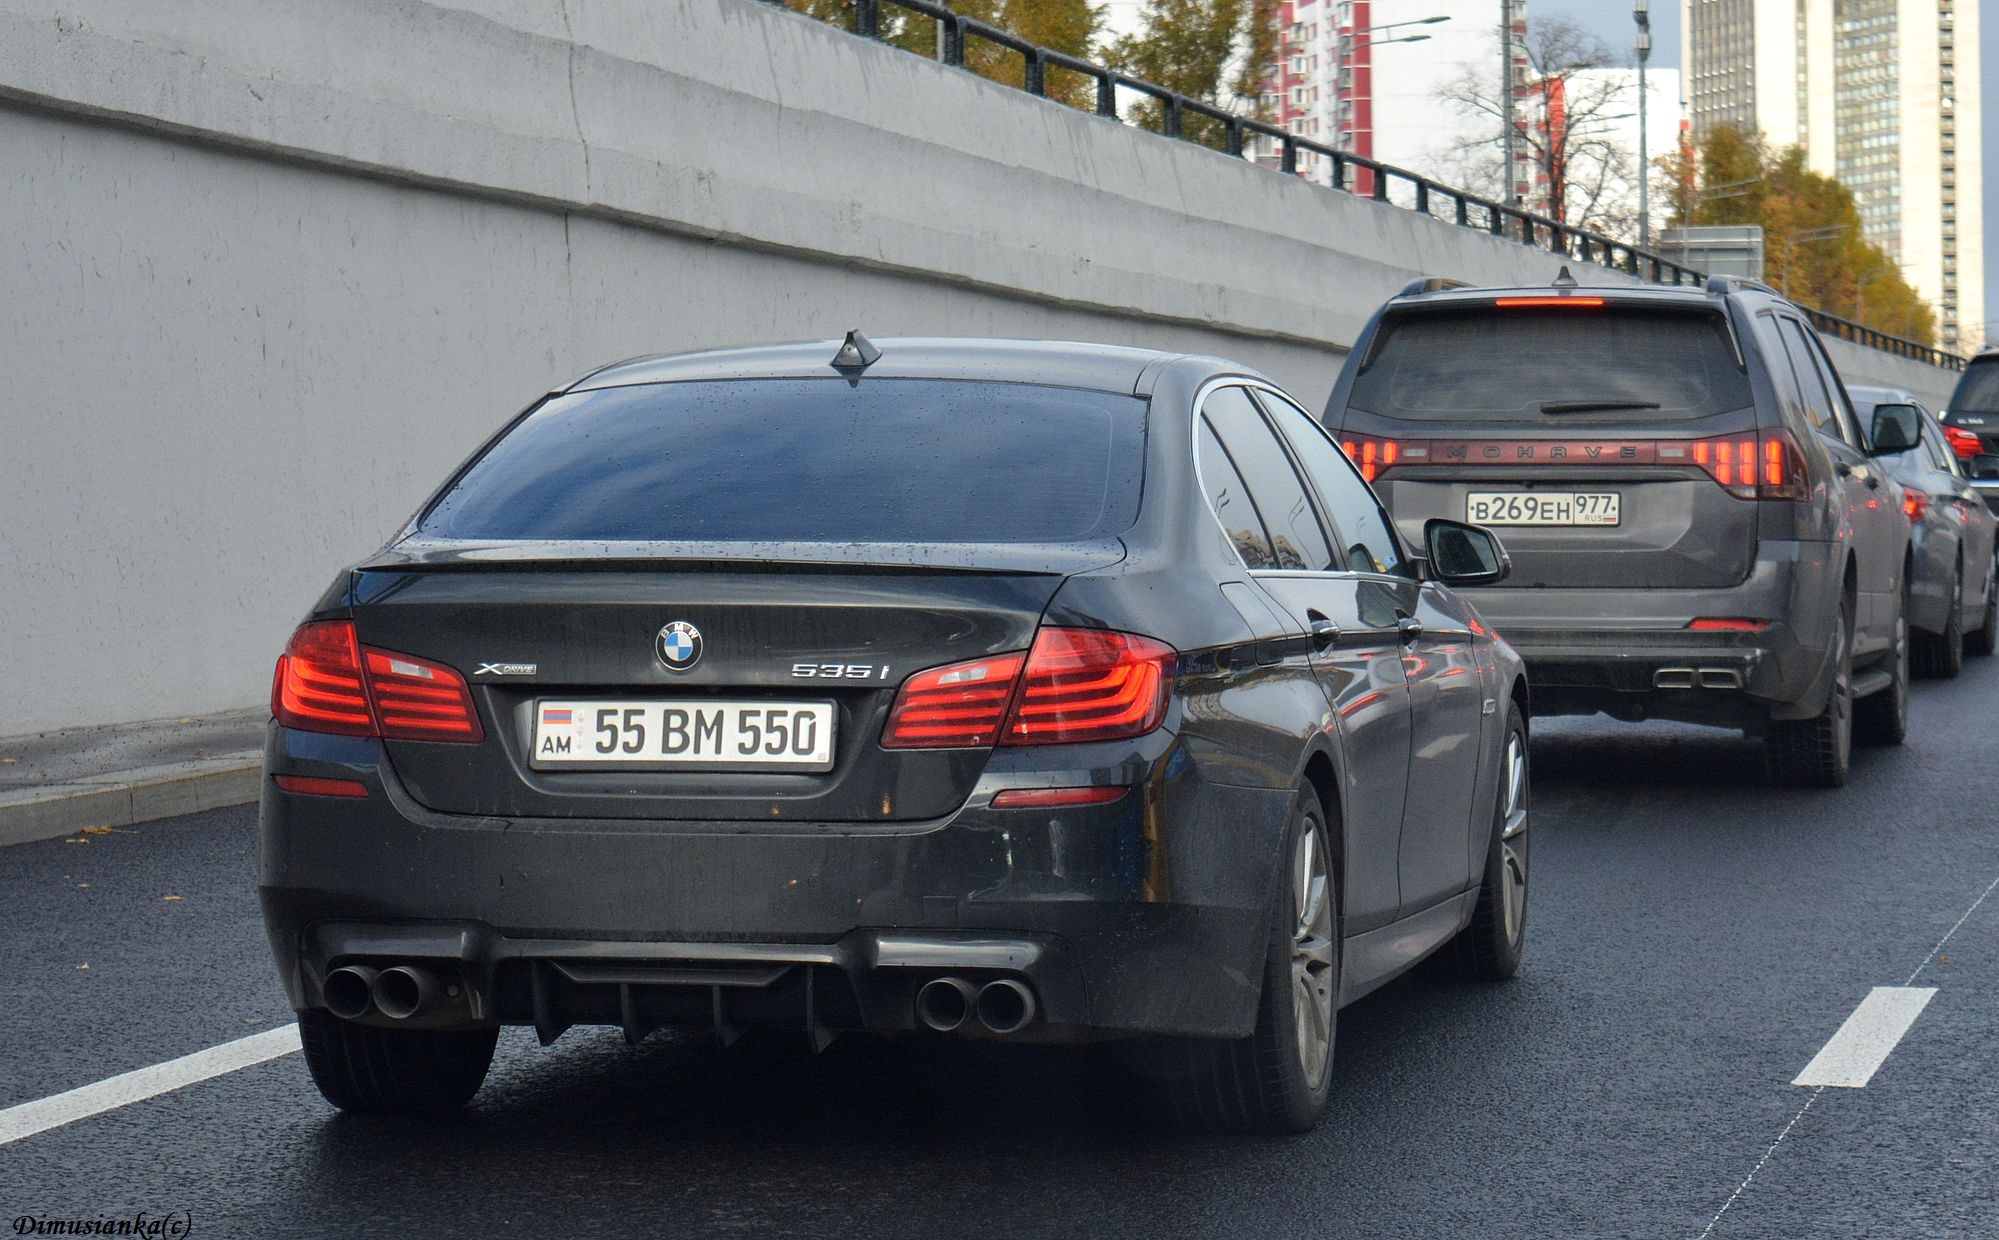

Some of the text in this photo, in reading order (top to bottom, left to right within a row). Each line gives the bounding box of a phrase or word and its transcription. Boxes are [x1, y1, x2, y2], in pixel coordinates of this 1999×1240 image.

[1446, 446, 1637, 459] MOHAVE
[1575, 495, 1613, 514] 977
[1584, 514, 1603, 522] RUS
[660, 623, 699, 639] BMW
[595, 708, 817, 756] 55 BM 550
[541, 735, 572, 754] AM
